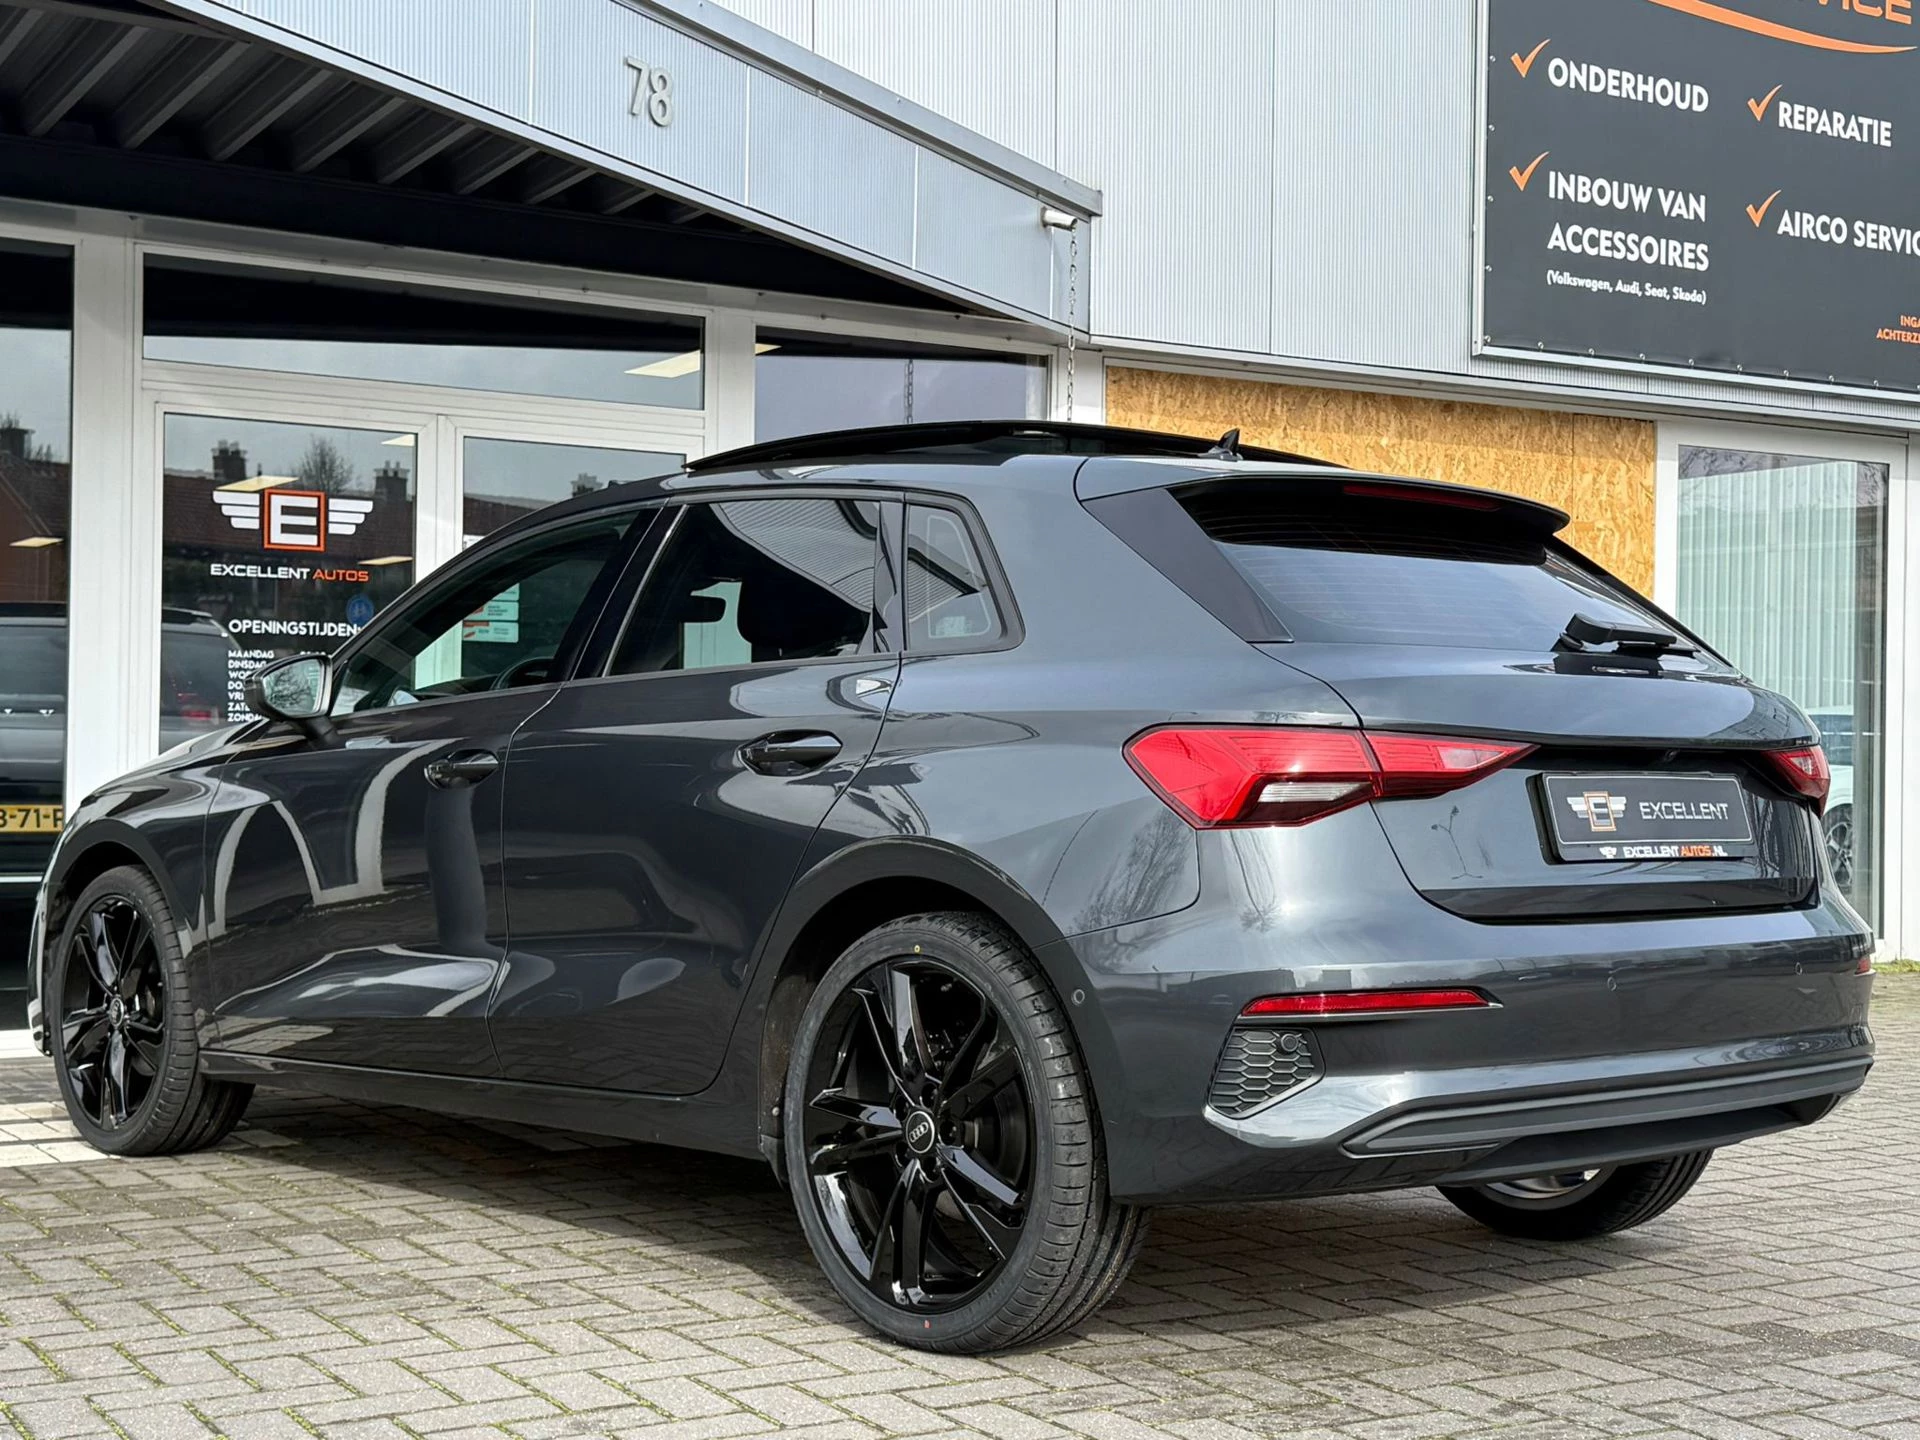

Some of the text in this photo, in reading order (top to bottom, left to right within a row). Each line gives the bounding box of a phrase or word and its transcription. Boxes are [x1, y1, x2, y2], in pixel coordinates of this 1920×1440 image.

[623, 56, 672, 127] 78
[1548, 58, 1709, 112] ONDERHOUD
[1778, 101, 1892, 147] REPARATIE
[1548, 171, 1706, 222] INBOUW VAN
[1777, 209, 1848, 244] AIRCO
[1547, 222, 1709, 272] ACCESSOIRES
[1546, 270, 1707, 305] (Volkswagen, Audi, Seat, Skoda)
[210, 564, 369, 582] EXCELLENT AUTOS
[227, 650, 274, 659] MAANDAG
[1639, 801, 1729, 820] EXCELLENT
